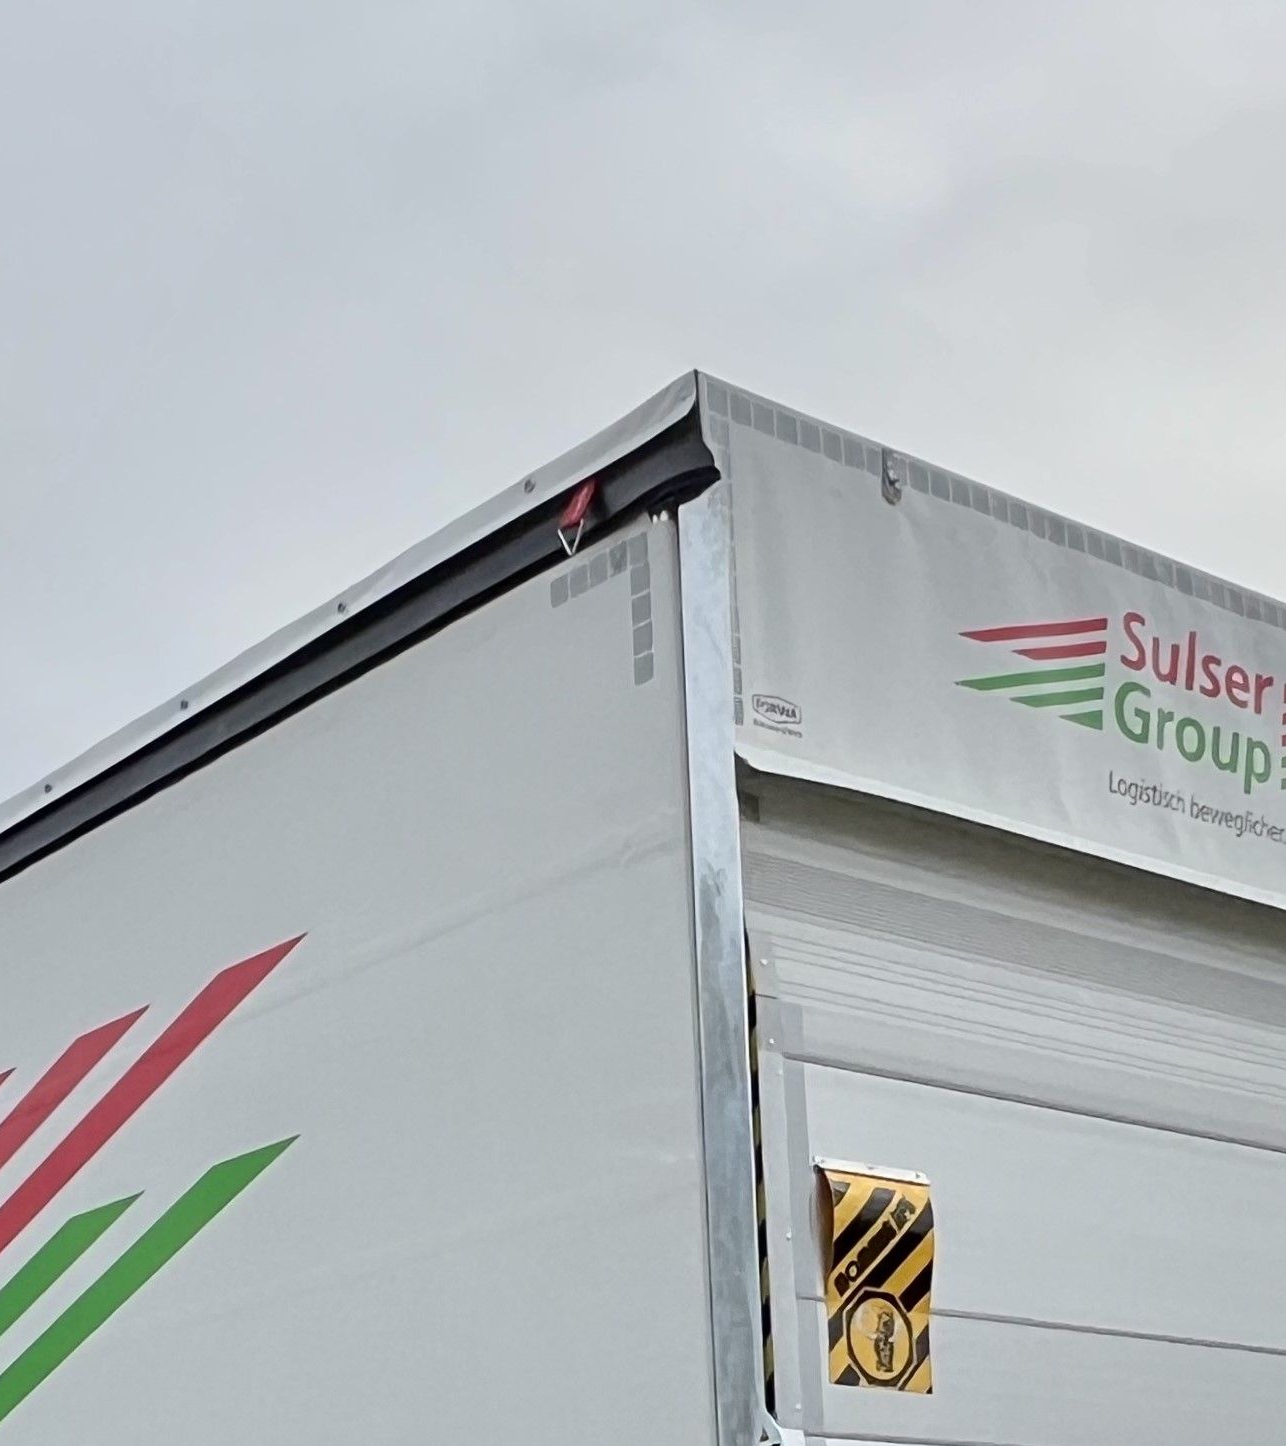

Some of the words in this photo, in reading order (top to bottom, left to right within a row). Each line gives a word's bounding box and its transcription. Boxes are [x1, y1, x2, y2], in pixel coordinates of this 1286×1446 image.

[1120, 611, 1274, 715] Sulser
[1115, 681, 1272, 794] Group
[1108, 770, 1186, 814] Logistisch
